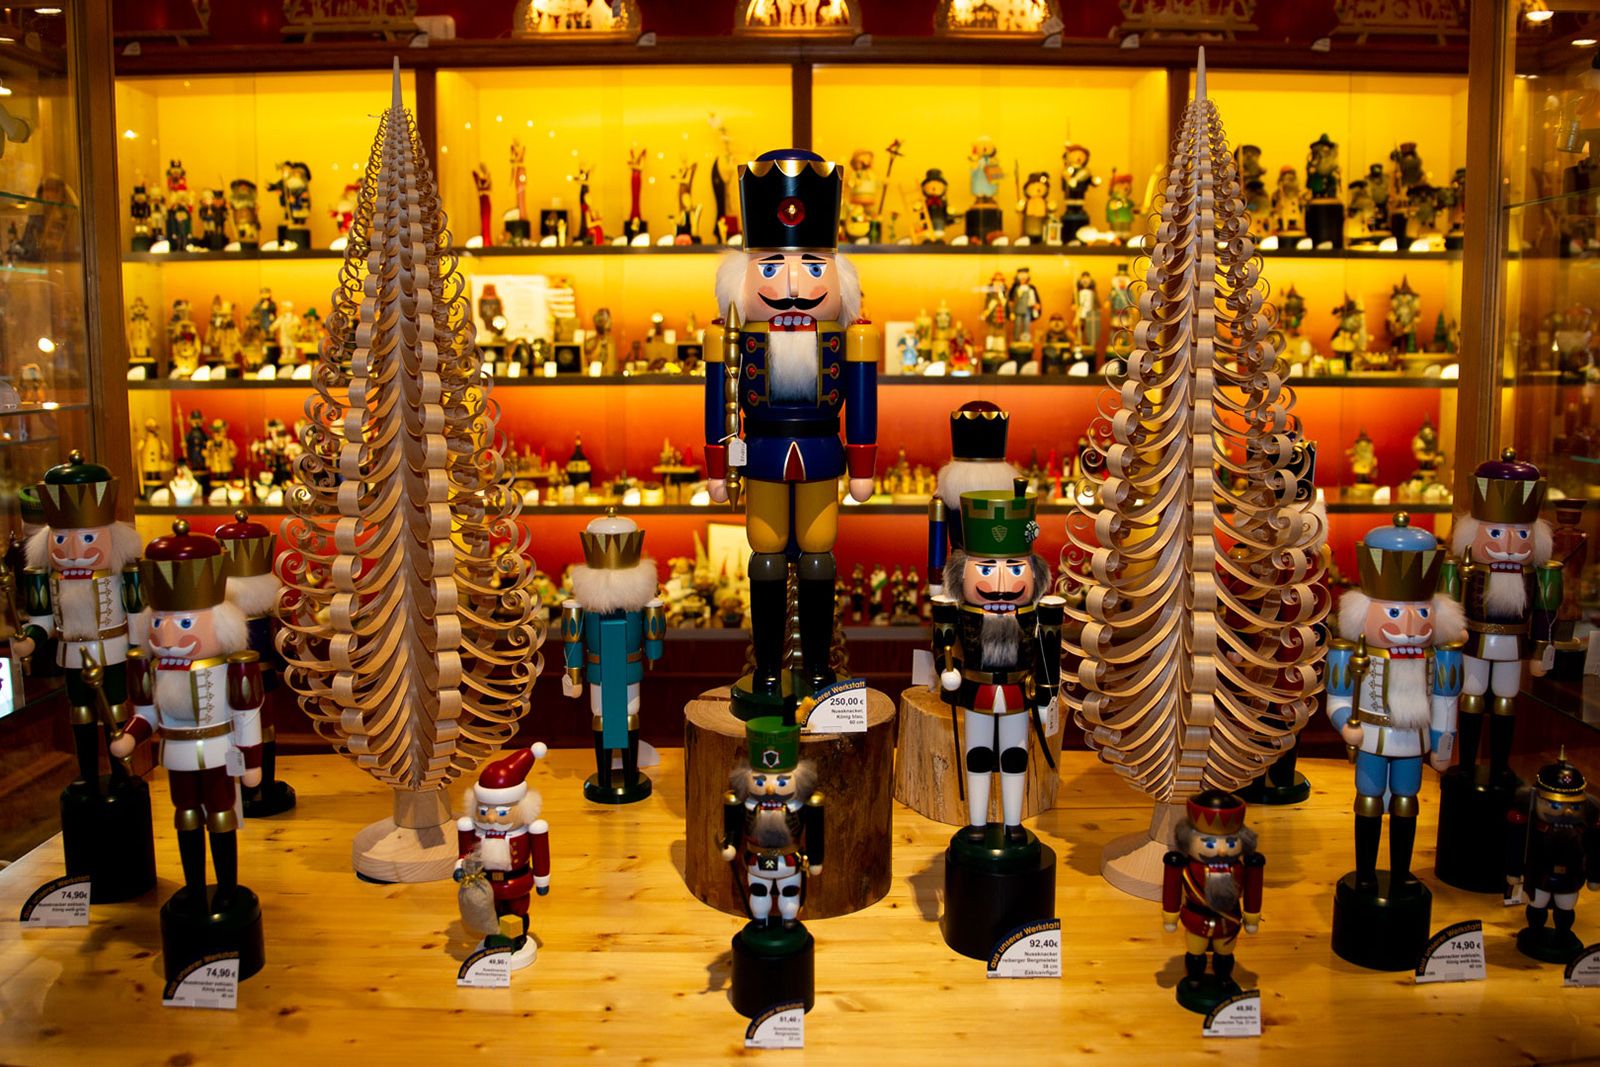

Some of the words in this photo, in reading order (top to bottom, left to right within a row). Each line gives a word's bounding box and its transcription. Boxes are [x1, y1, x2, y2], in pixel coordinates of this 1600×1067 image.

[831, 681, 866, 693] Werkstatt
[830, 697, 858, 706] 250,00
[998, 931, 1023, 954] unserer
[1023, 922, 1060, 935] Werkstatt
[1451, 941, 1475, 950] 74,90
[206, 968, 231, 978] 74,90
